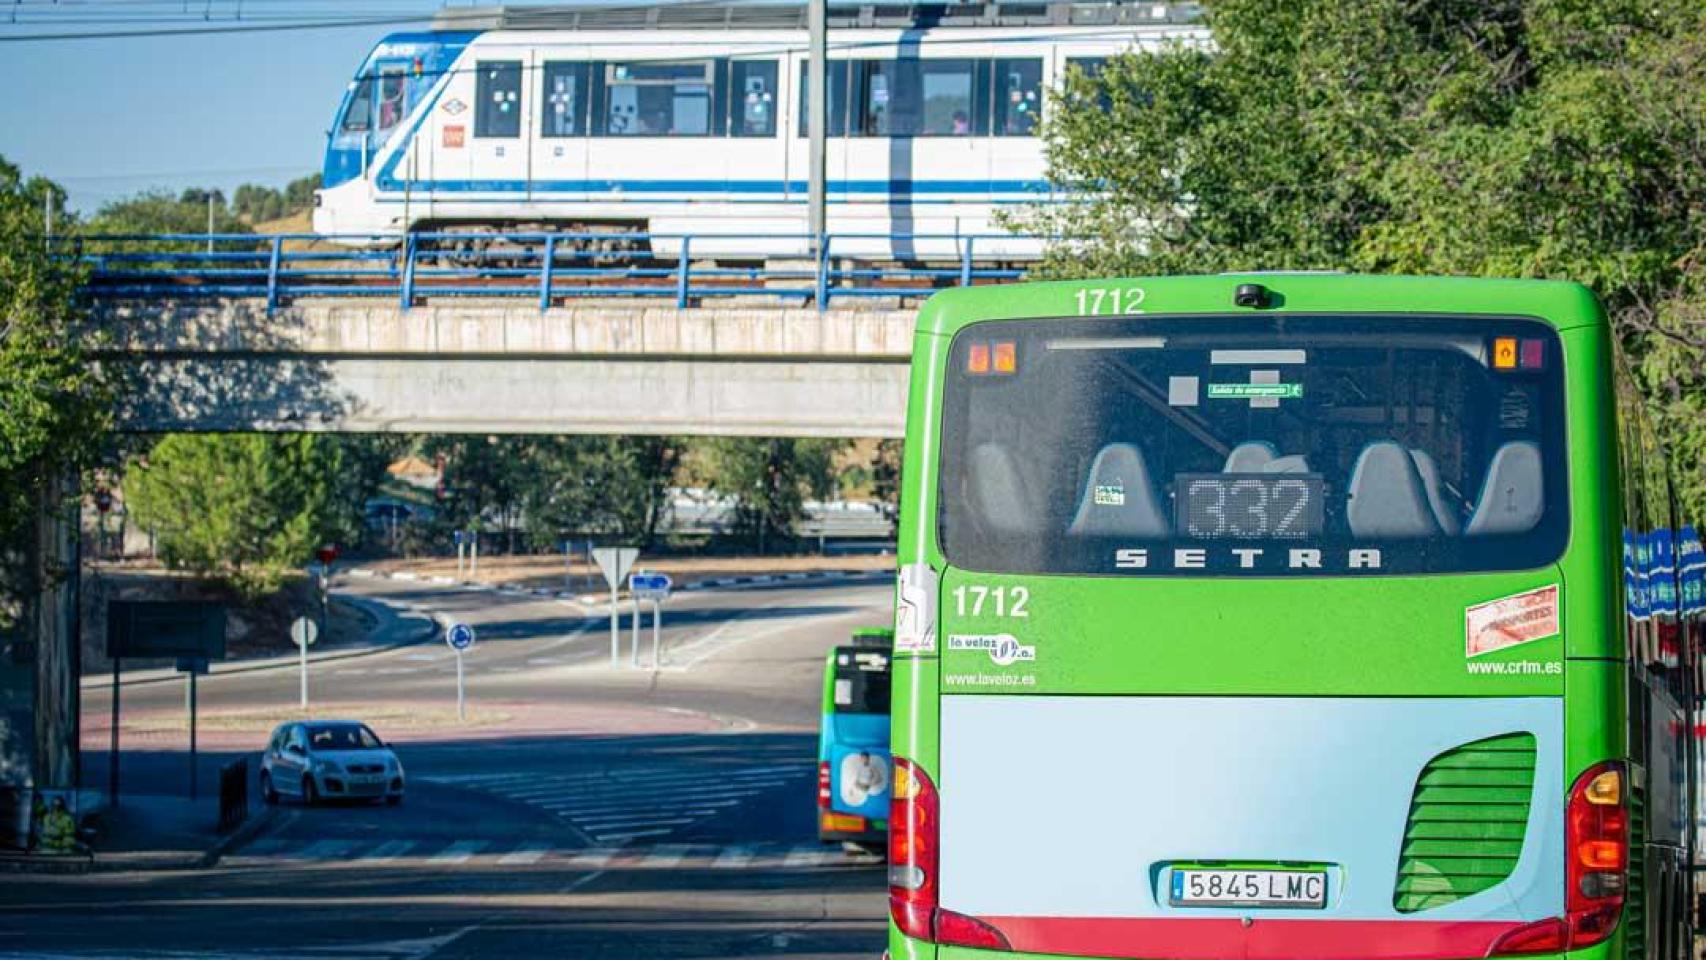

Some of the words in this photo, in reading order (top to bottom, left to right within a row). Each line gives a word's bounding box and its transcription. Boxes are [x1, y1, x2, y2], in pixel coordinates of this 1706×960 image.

[1074, 288, 1145, 316] 1712
[1188, 479, 1309, 539] 332
[1115, 549, 1381, 568] SETRA
[953, 585, 1029, 616] 1712
[951, 637, 963, 648] la
[965, 637, 998, 648] veloz
[1467, 660, 1562, 675] www.crtm.es
[945, 672, 1036, 686] www.laveloz.es
[1190, 874, 1260, 898] 5845
[1269, 875, 1320, 899] LMC
